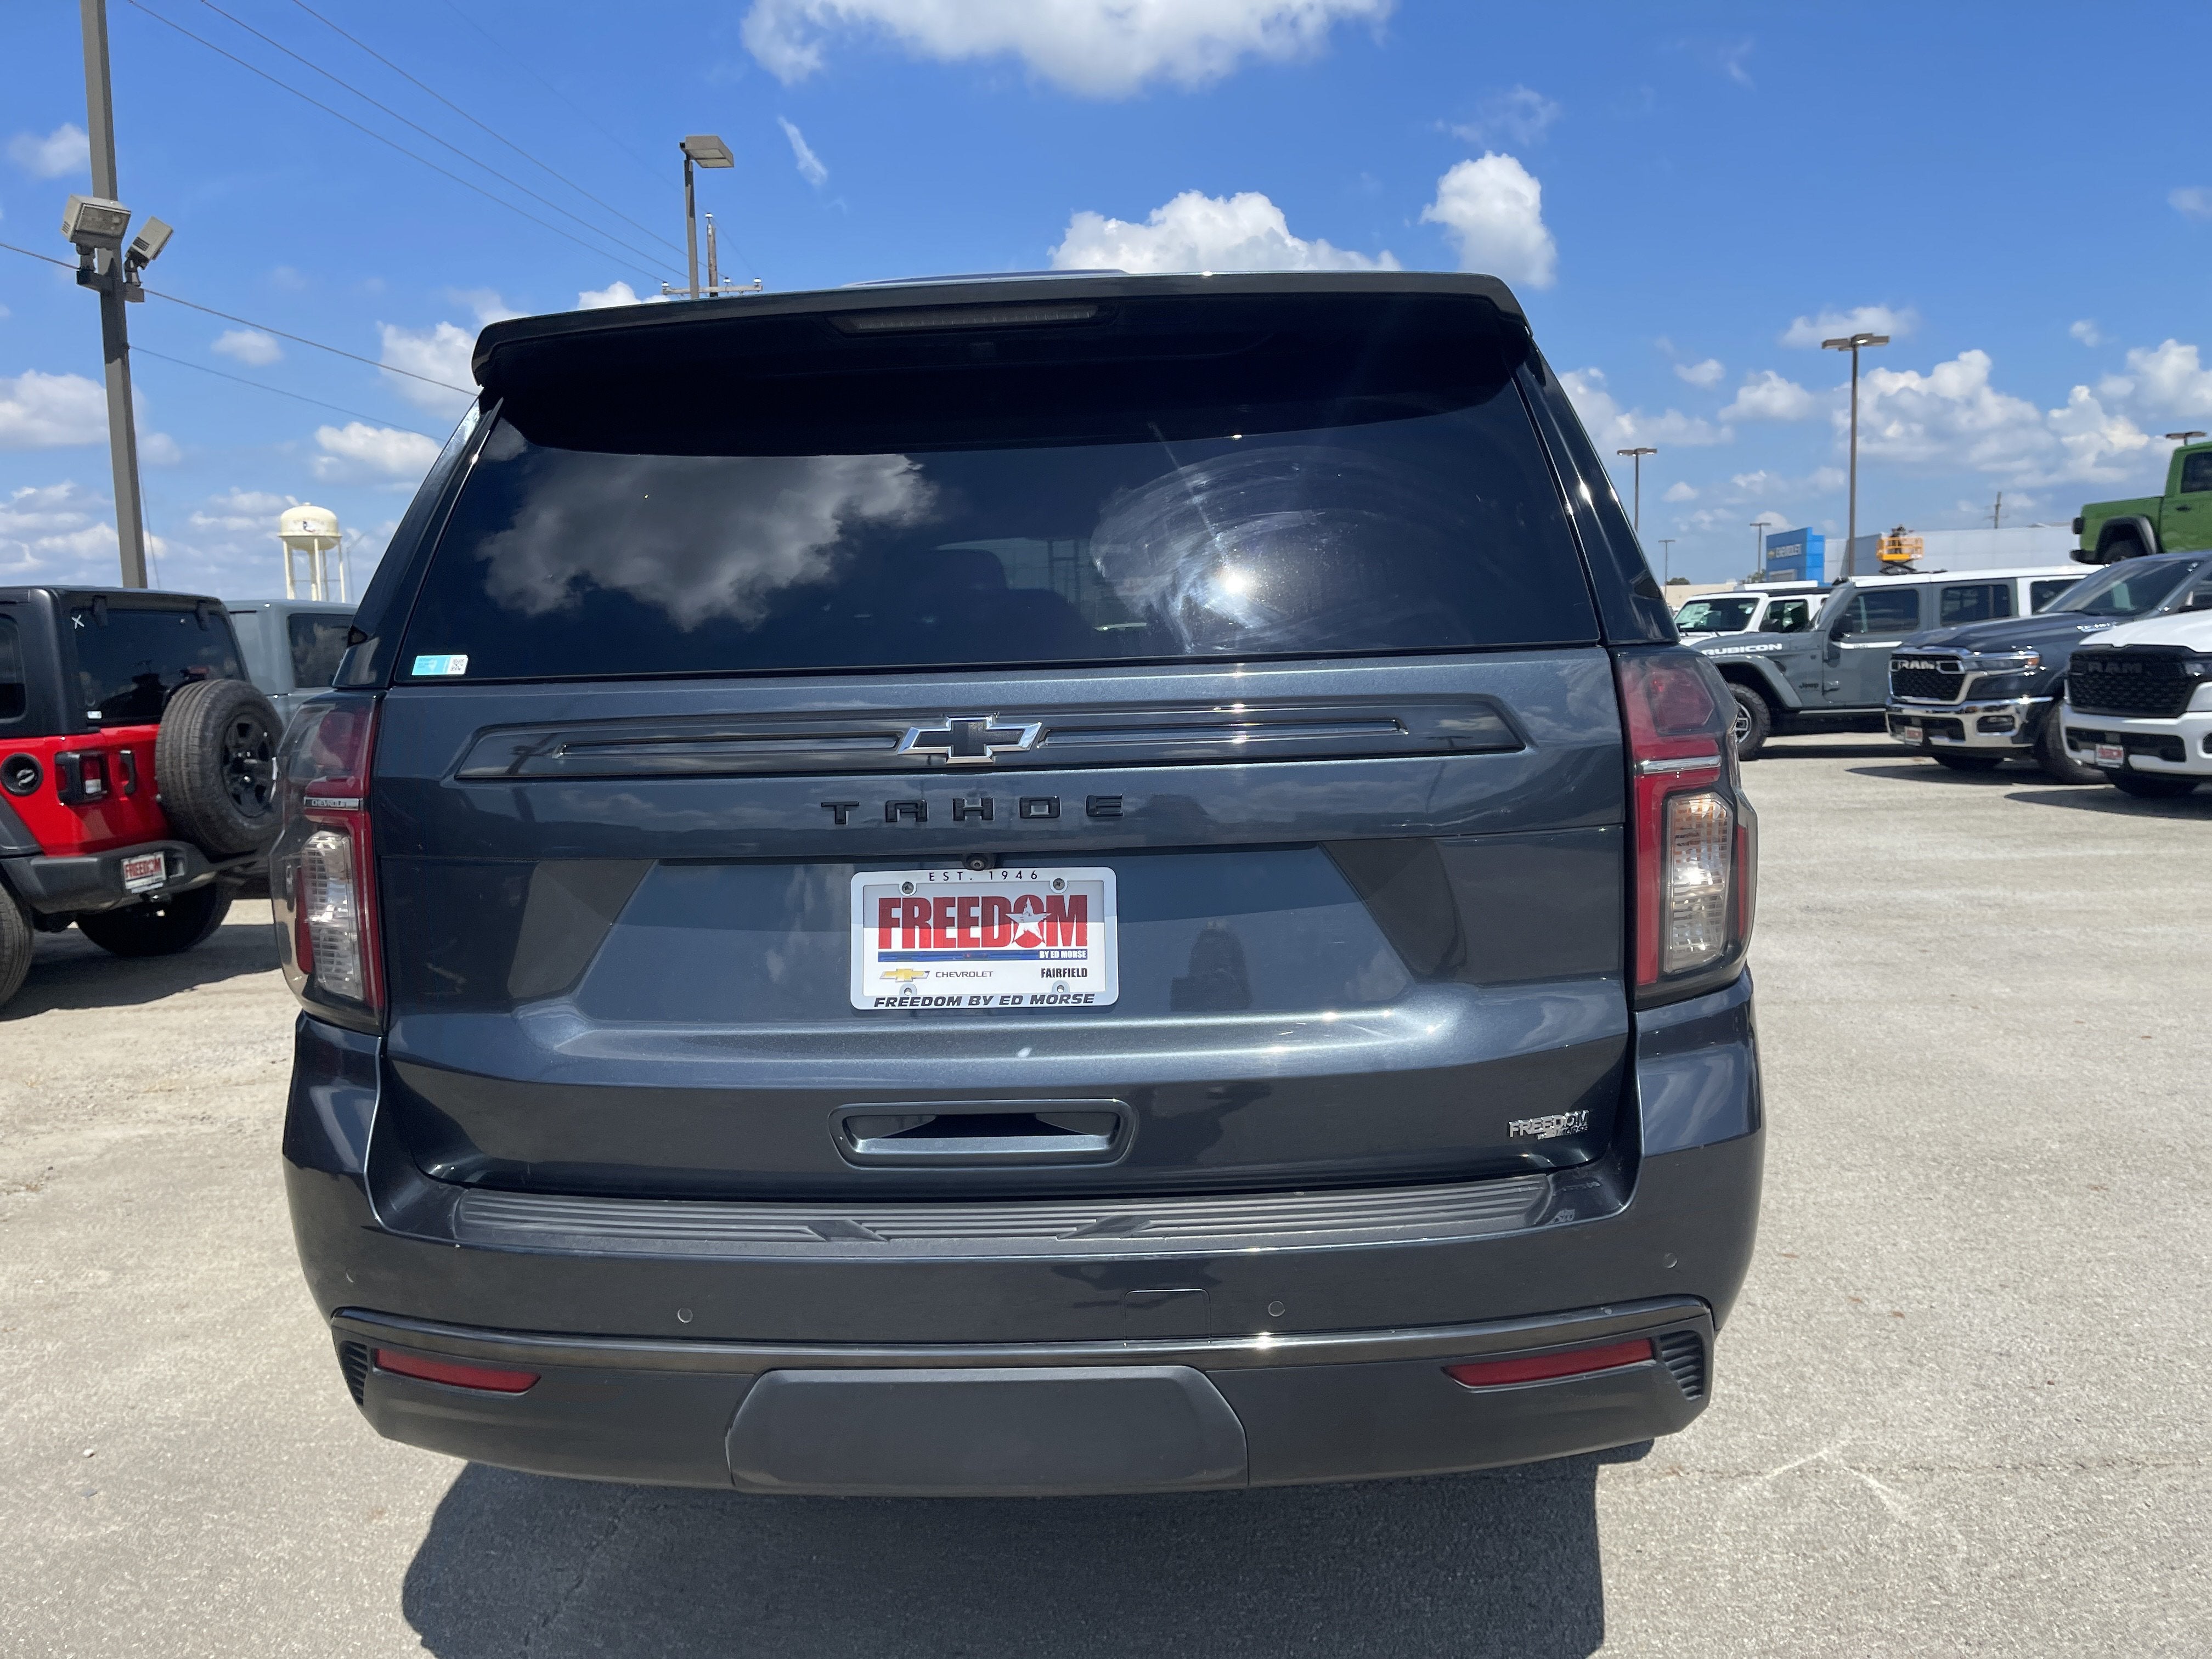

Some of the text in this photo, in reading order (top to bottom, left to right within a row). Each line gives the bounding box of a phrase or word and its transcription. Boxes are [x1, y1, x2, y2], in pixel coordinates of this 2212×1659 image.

[1701, 643, 1782, 656] RUBICON
[1899, 660, 1936, 670] RAM
[821, 794, 1124, 825] TAHOE
[929, 870, 1038, 882] EST. 1946
[878, 895, 1088, 949] FREEDOM
[1051, 951, 1060, 959] ED
[1061, 950, 1086, 958] MORSE
[935, 970, 994, 978] CHEVROLET
[1041, 968, 1088, 978] FAIRFIELD
[873, 993, 1096, 1008] FREEDOM BY ED MORSE
[1509, 1110, 1589, 1137] FREEDOM
